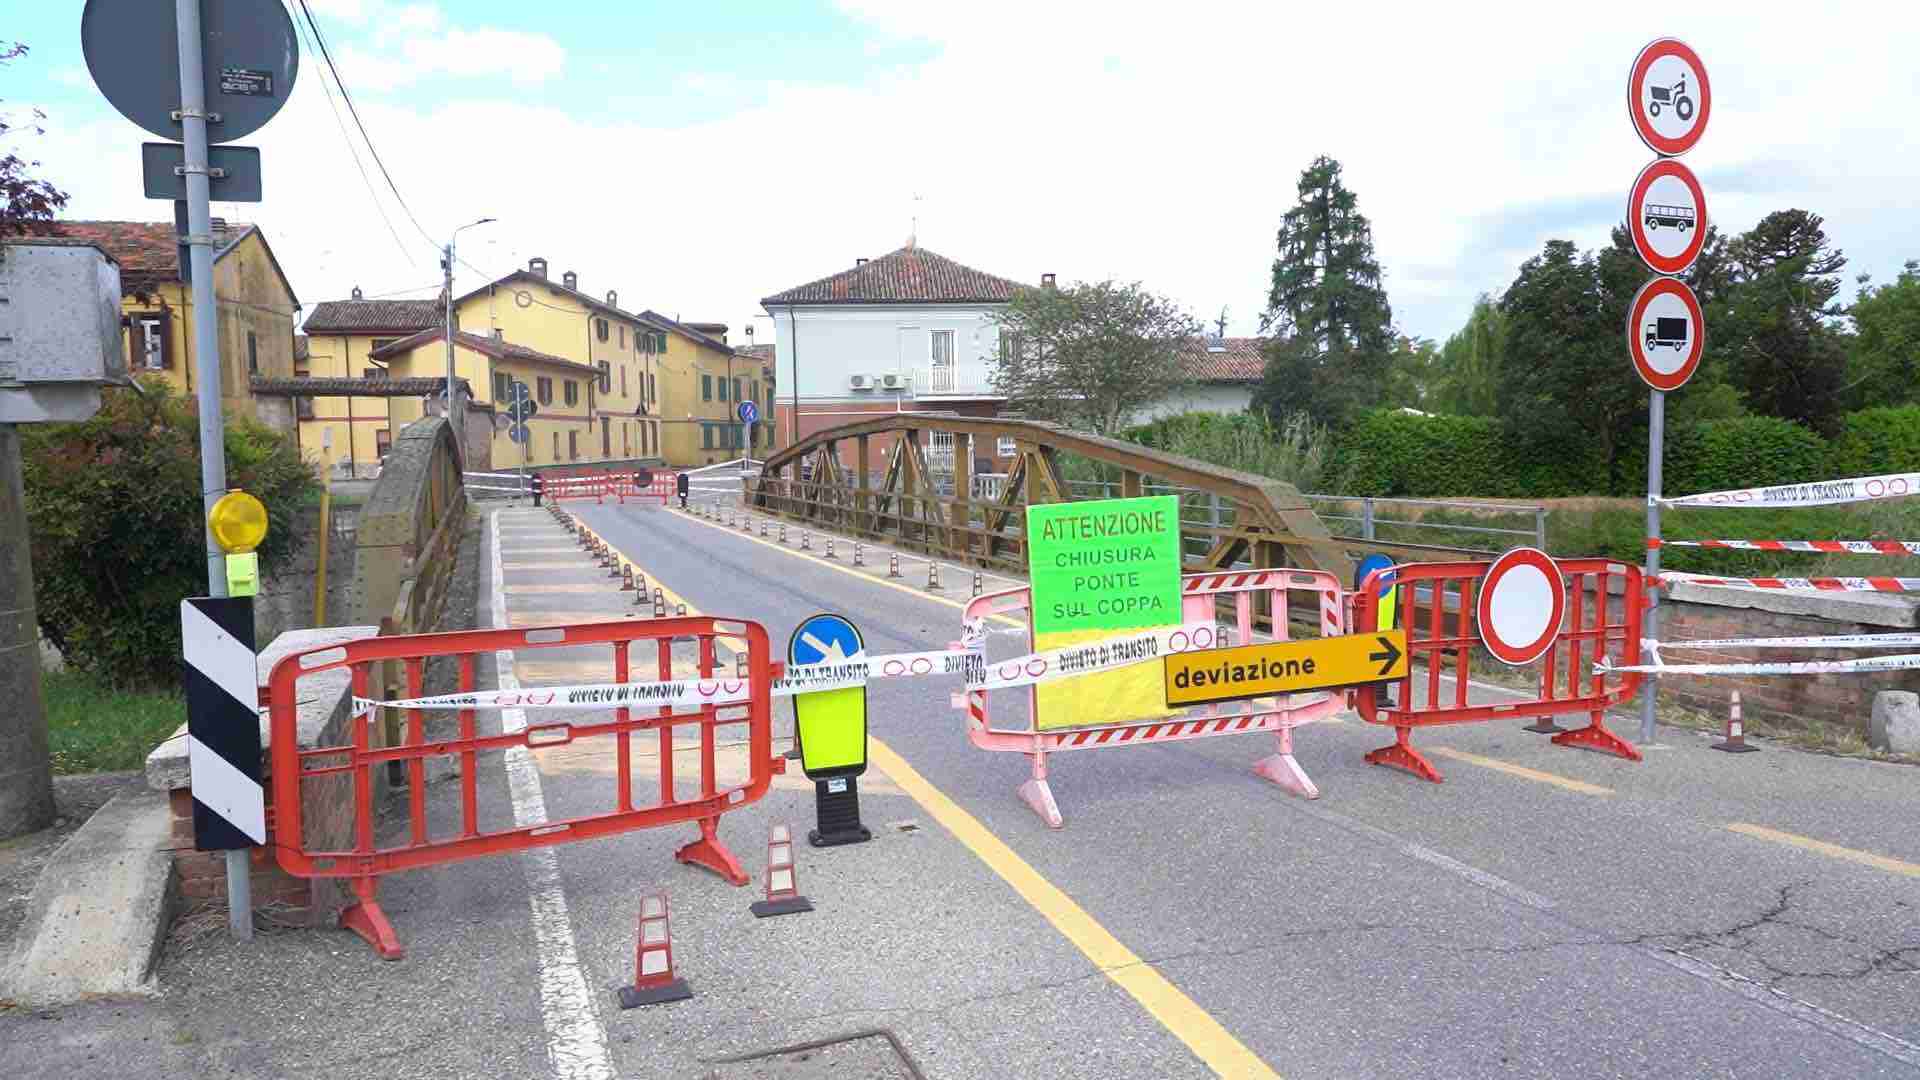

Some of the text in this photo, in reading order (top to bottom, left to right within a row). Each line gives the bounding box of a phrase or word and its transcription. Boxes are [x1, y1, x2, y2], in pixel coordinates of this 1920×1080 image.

[1043, 511, 1166, 540] ATTENZIONE
[1056, 547, 1156, 568] CHIUSURA
[1075, 572, 1140, 592] PONTE
[1053, 596, 1162, 618] SUL COPPA
[945, 654, 983, 673] DIVIETO
[1059, 636, 1157, 671] DIVIETO DI TRANSITO
[819, 663, 870, 680] TRANSITO
[1175, 657, 1316, 688] deviazione
